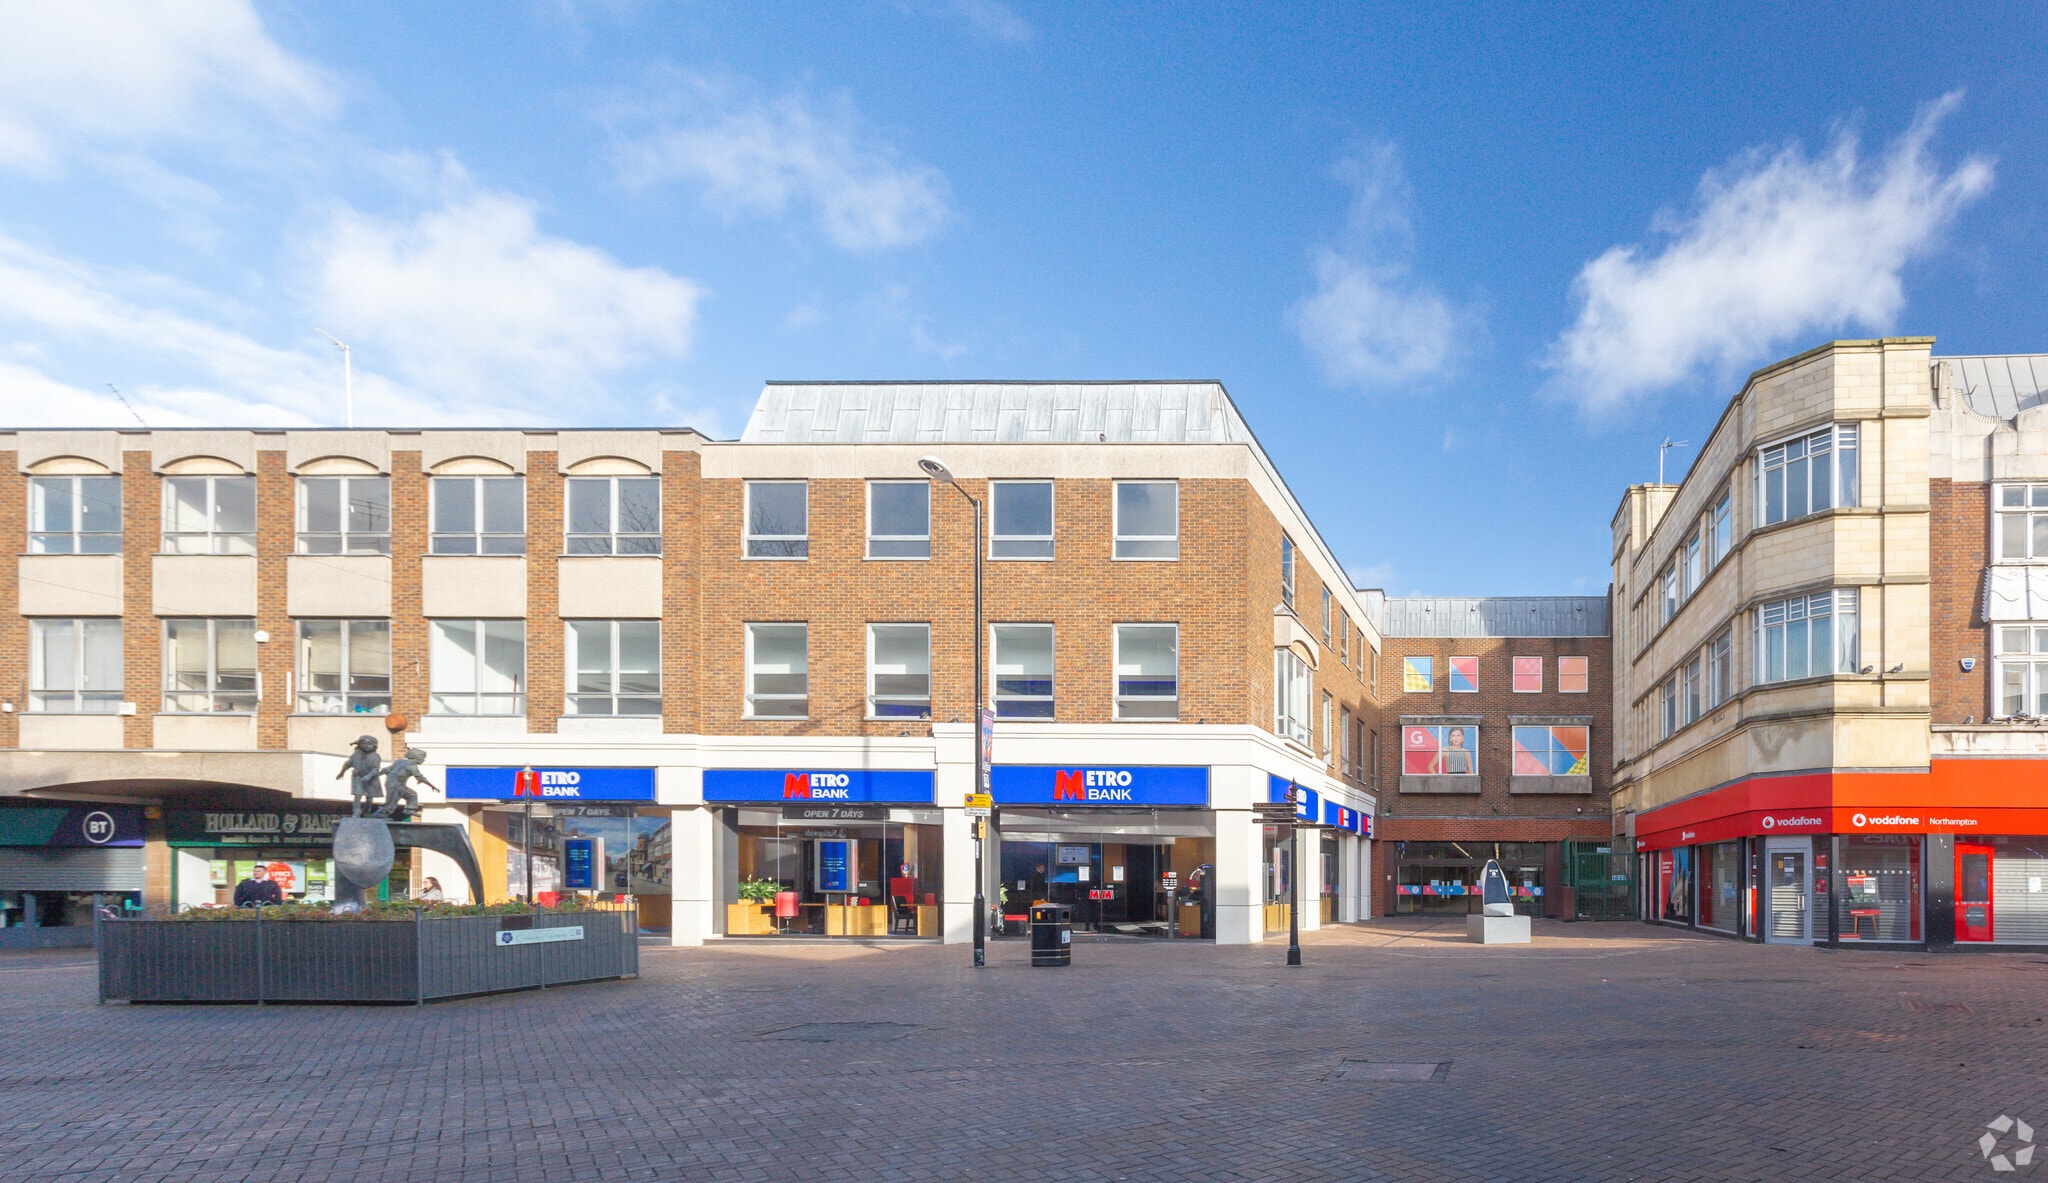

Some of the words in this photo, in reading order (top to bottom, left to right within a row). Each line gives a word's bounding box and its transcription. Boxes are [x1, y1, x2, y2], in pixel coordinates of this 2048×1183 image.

[514, 771, 581, 797] METRO
[783, 773, 850, 799] METRO
[1053, 770, 1132, 800] METRO
[543, 786, 581, 797] BANK
[812, 788, 849, 799] BANK
[1088, 788, 1133, 800] BANK
[577, 806, 587, 816] 7
[586, 808, 610, 816] DAYS
[803, 810, 830, 818] OPEN
[831, 808, 840, 818] 7
[840, 810, 864, 818] DAYS
[205, 813, 280, 832] HOLLAND
[1776, 816, 1823, 827] vodafone
[1868, 815, 1920, 825] vodafone
[1929, 817, 1978, 827] Northampton
[89, 821, 108, 834] BT
